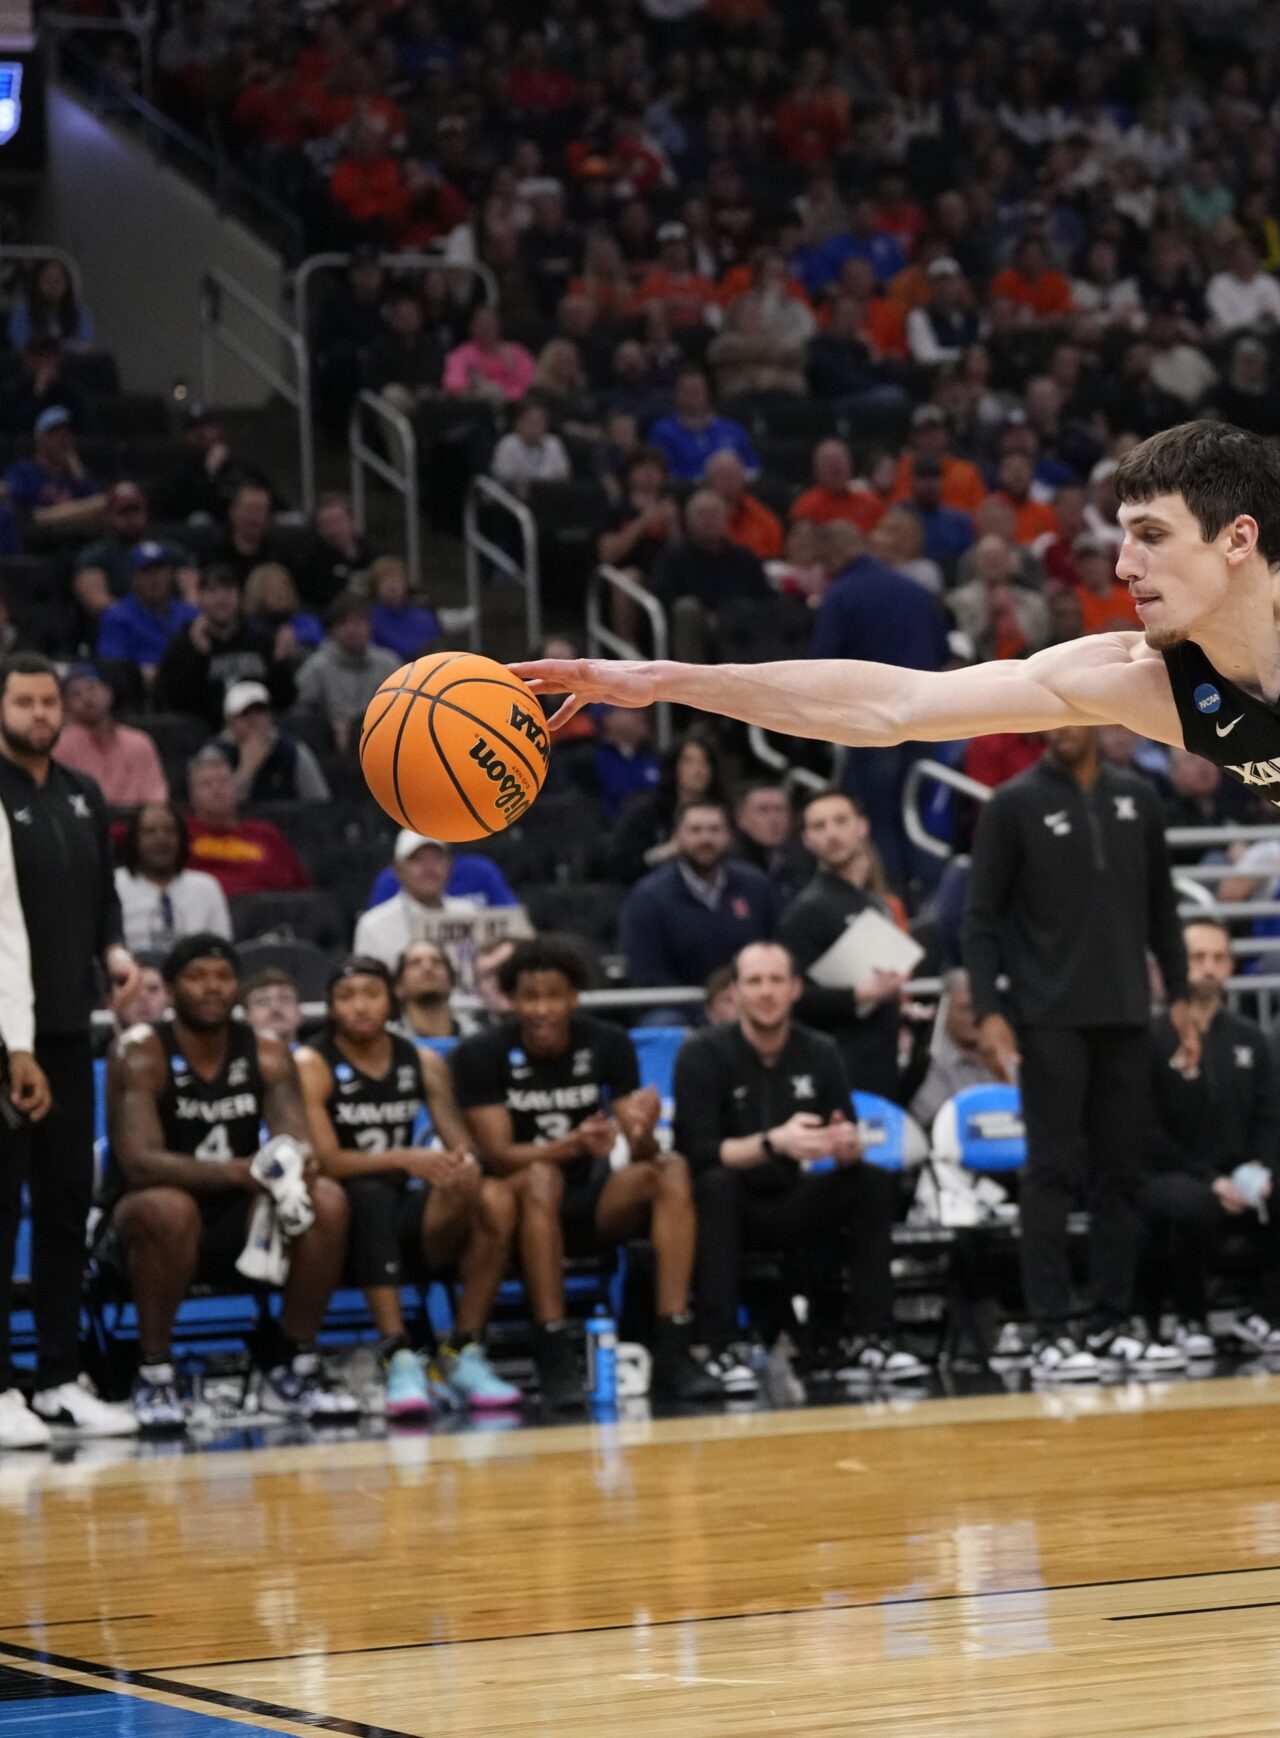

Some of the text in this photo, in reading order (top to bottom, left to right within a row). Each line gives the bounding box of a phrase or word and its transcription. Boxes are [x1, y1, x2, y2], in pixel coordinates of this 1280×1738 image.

[1199, 693, 1221, 710] NCAA
[469, 736, 532, 825] Wilson
[195, 1123, 234, 1162] 4
